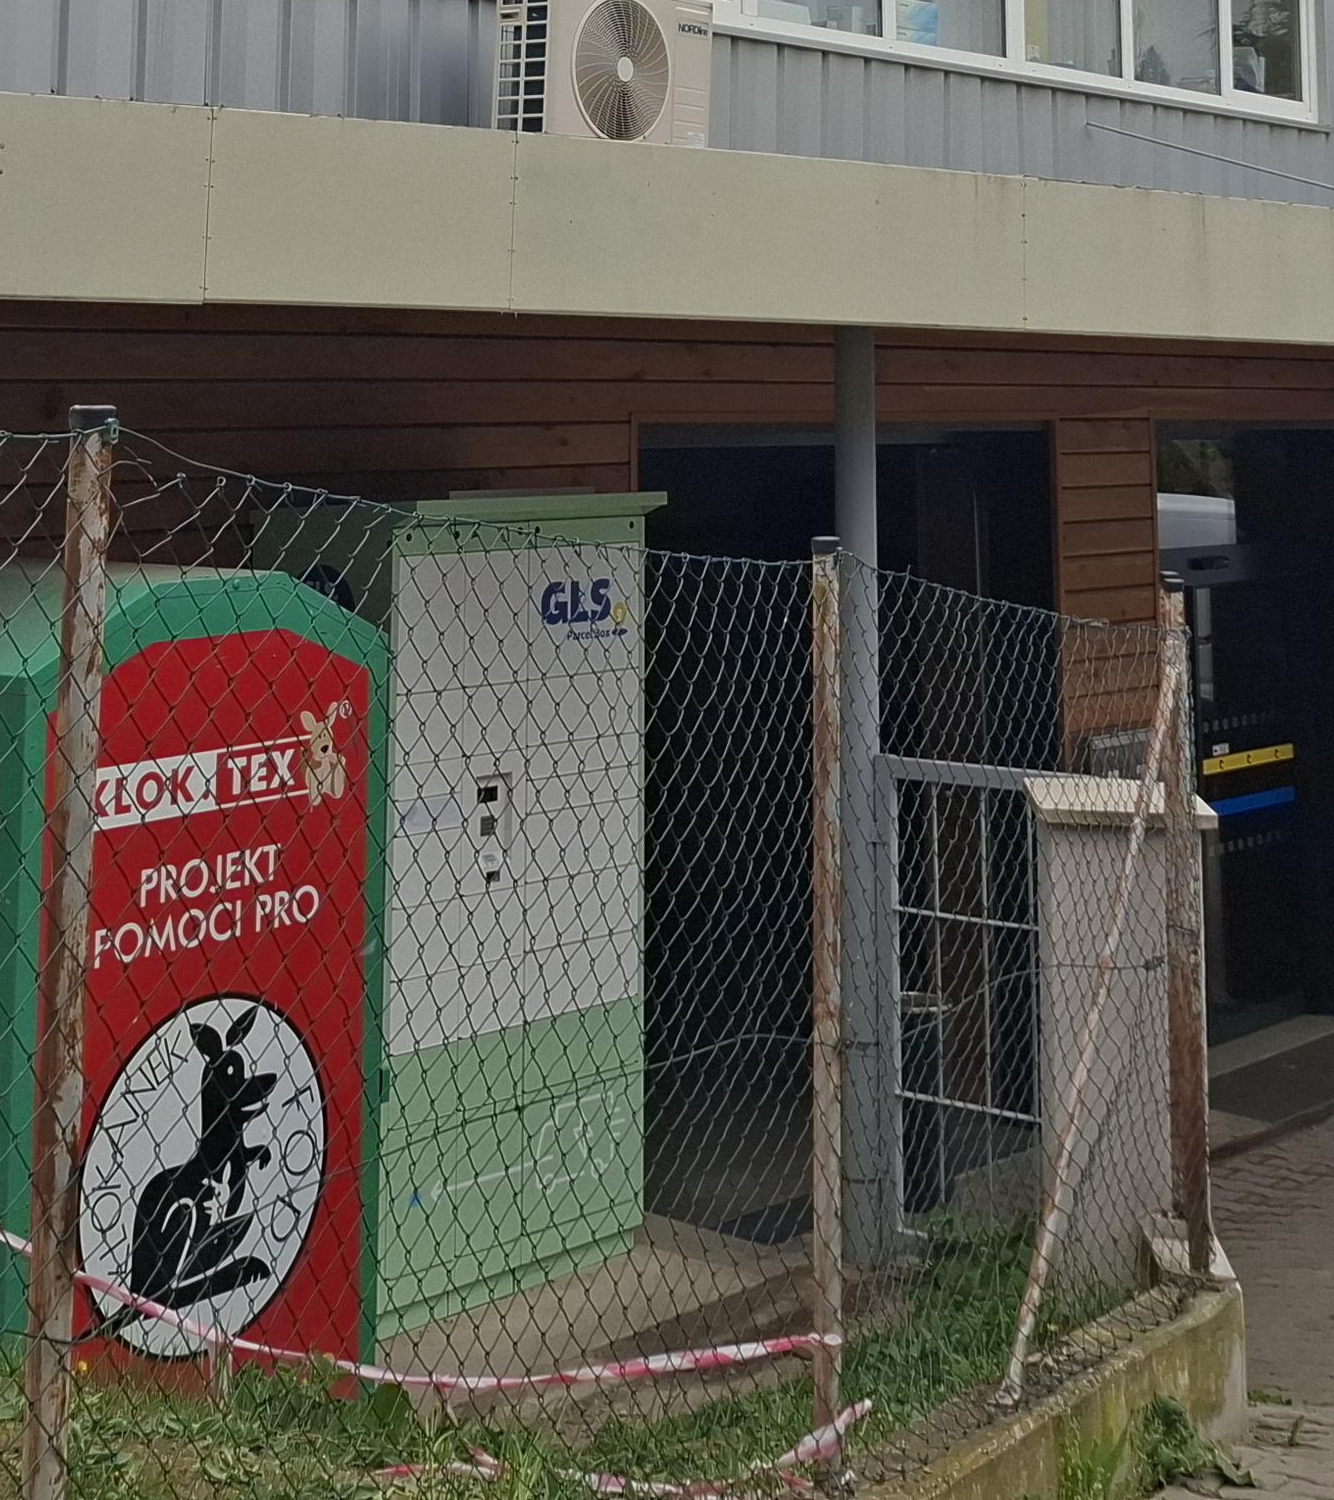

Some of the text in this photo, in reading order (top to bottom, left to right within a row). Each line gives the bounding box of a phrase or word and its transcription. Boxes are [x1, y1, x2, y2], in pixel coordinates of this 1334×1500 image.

[541, 578, 612, 626] GLS
[227, 748, 296, 796] TEX
[140, 843, 282, 908] PROJEKT
[93, 884, 319, 970] POMOCI PRO
